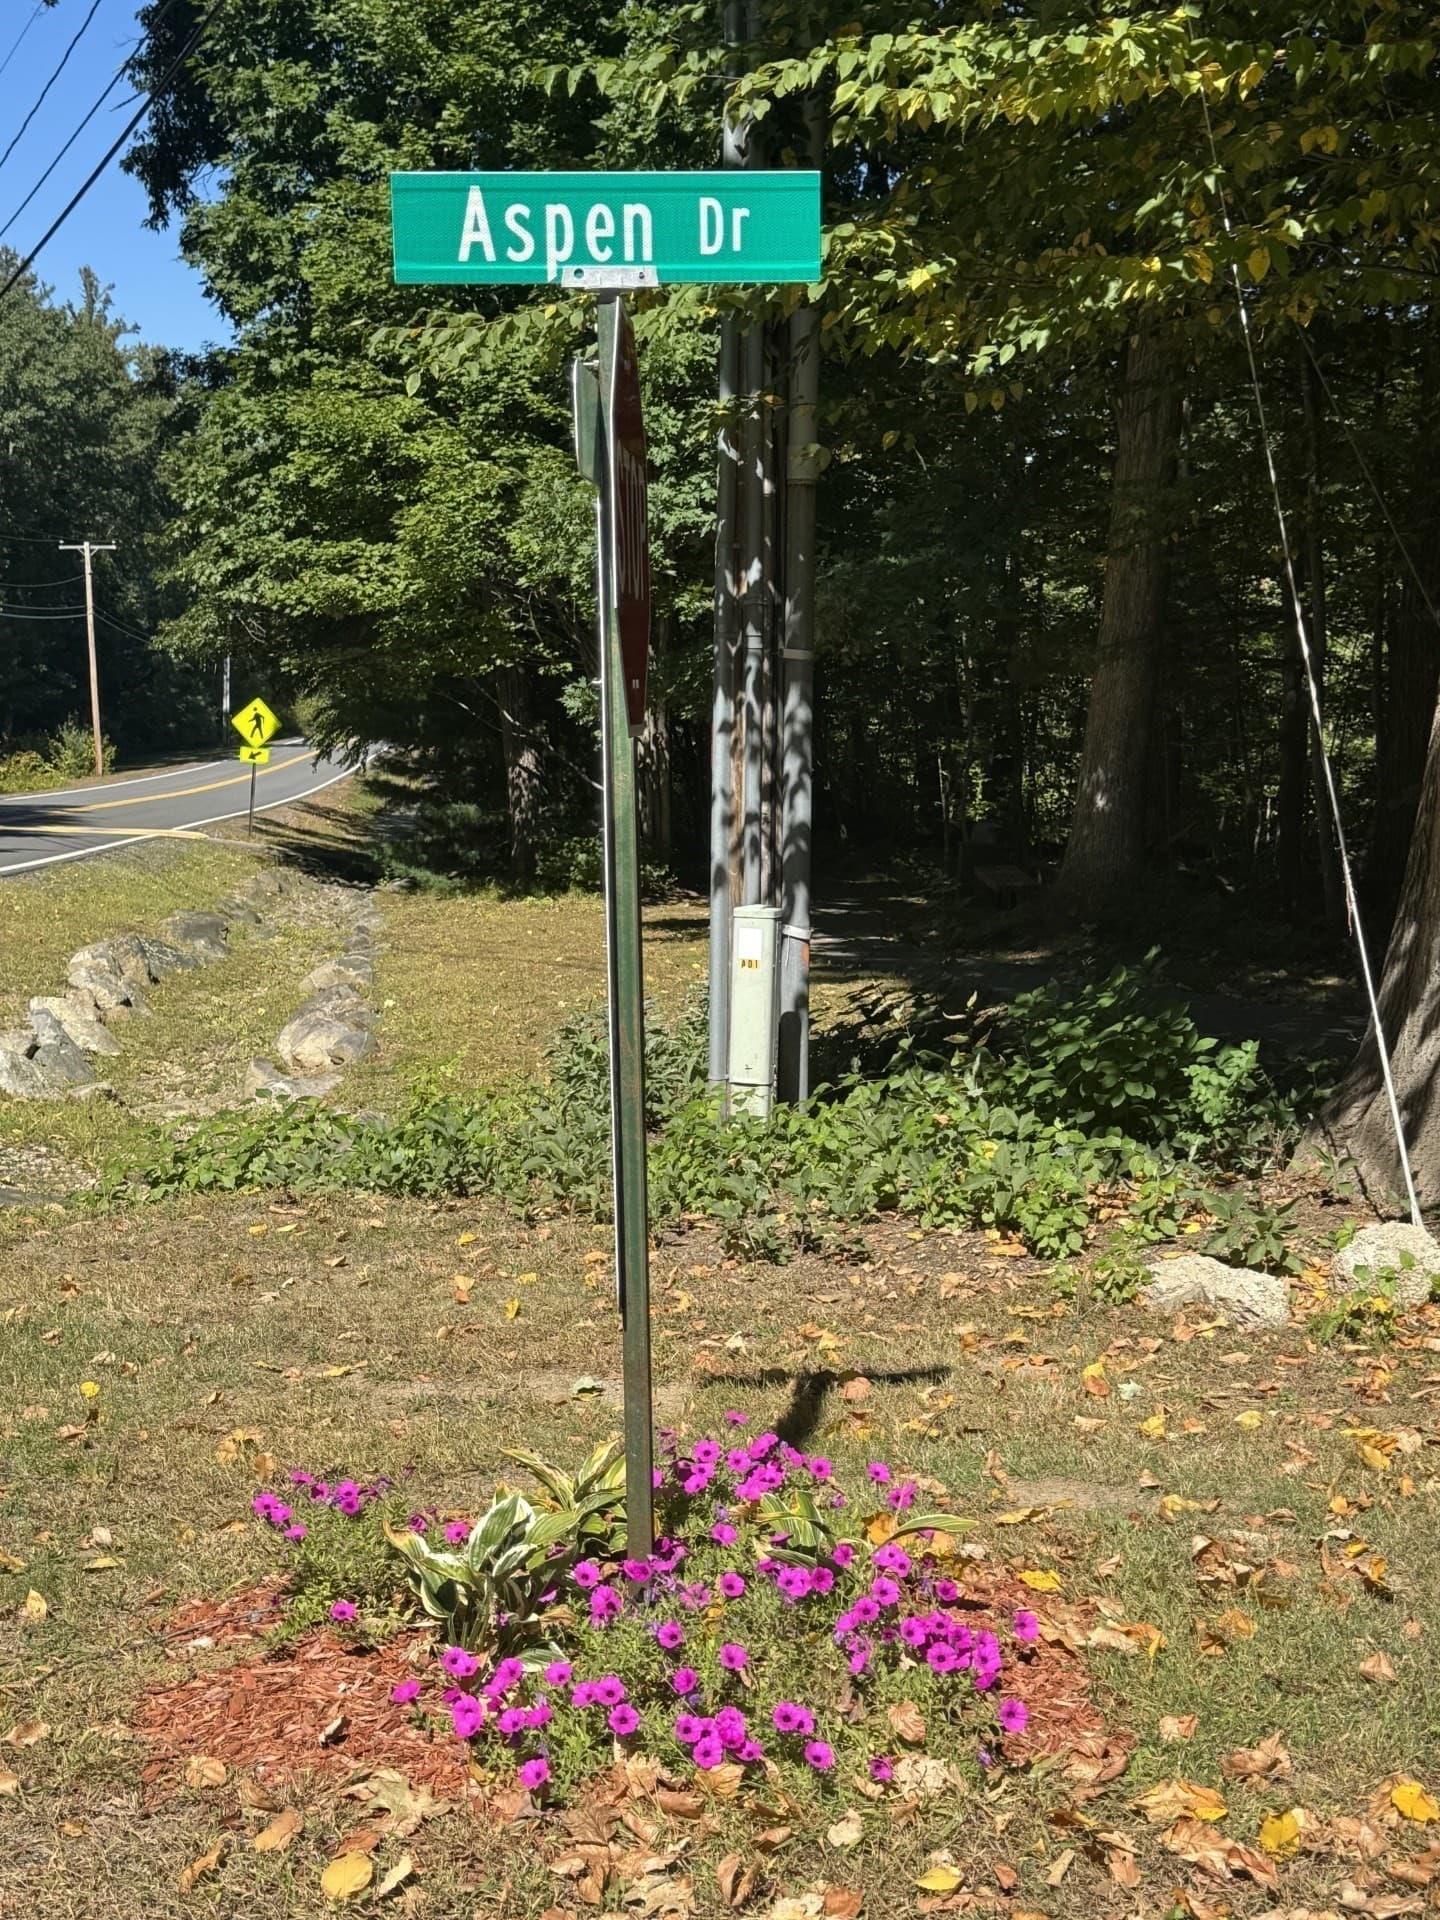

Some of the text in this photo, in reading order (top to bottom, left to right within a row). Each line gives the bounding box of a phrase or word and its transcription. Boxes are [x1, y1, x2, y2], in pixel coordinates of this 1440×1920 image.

[458, 185, 750, 282] Aspen Dr
[616, 439, 647, 601] STOP
